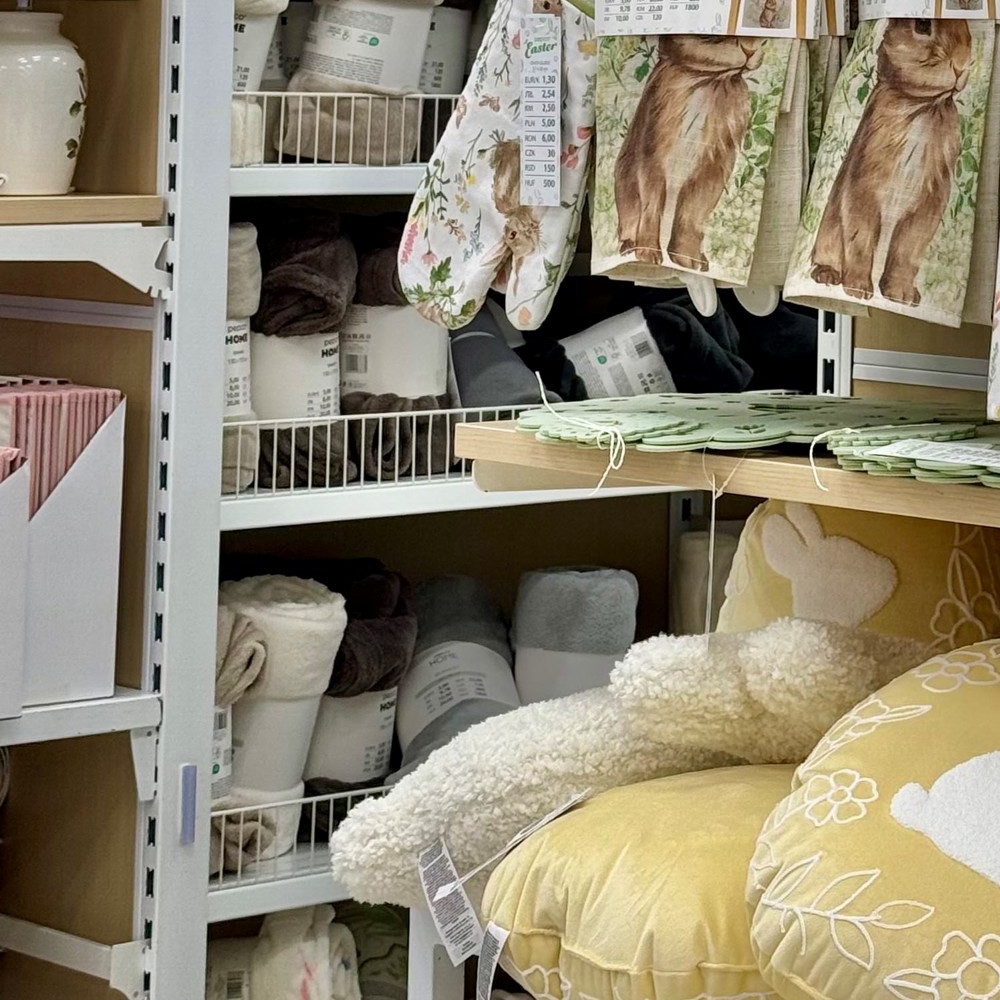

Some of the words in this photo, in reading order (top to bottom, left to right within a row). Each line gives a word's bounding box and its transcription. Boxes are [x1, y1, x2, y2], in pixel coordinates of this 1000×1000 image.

[524, 39, 557, 59] Easter
[542, 75, 556, 85] 1,30
[541, 90, 555, 98] 2,54
[542, 104, 556, 113] 2,50
[541, 119, 556, 128] 5,00
[541, 134, 556, 143] 6,00
[525, 149, 536, 157] CZK
[547, 149, 556, 158] 30
[544, 164, 556, 172] 150
[543, 179, 556, 188] 500
[225, 333, 248, 345] HOME
